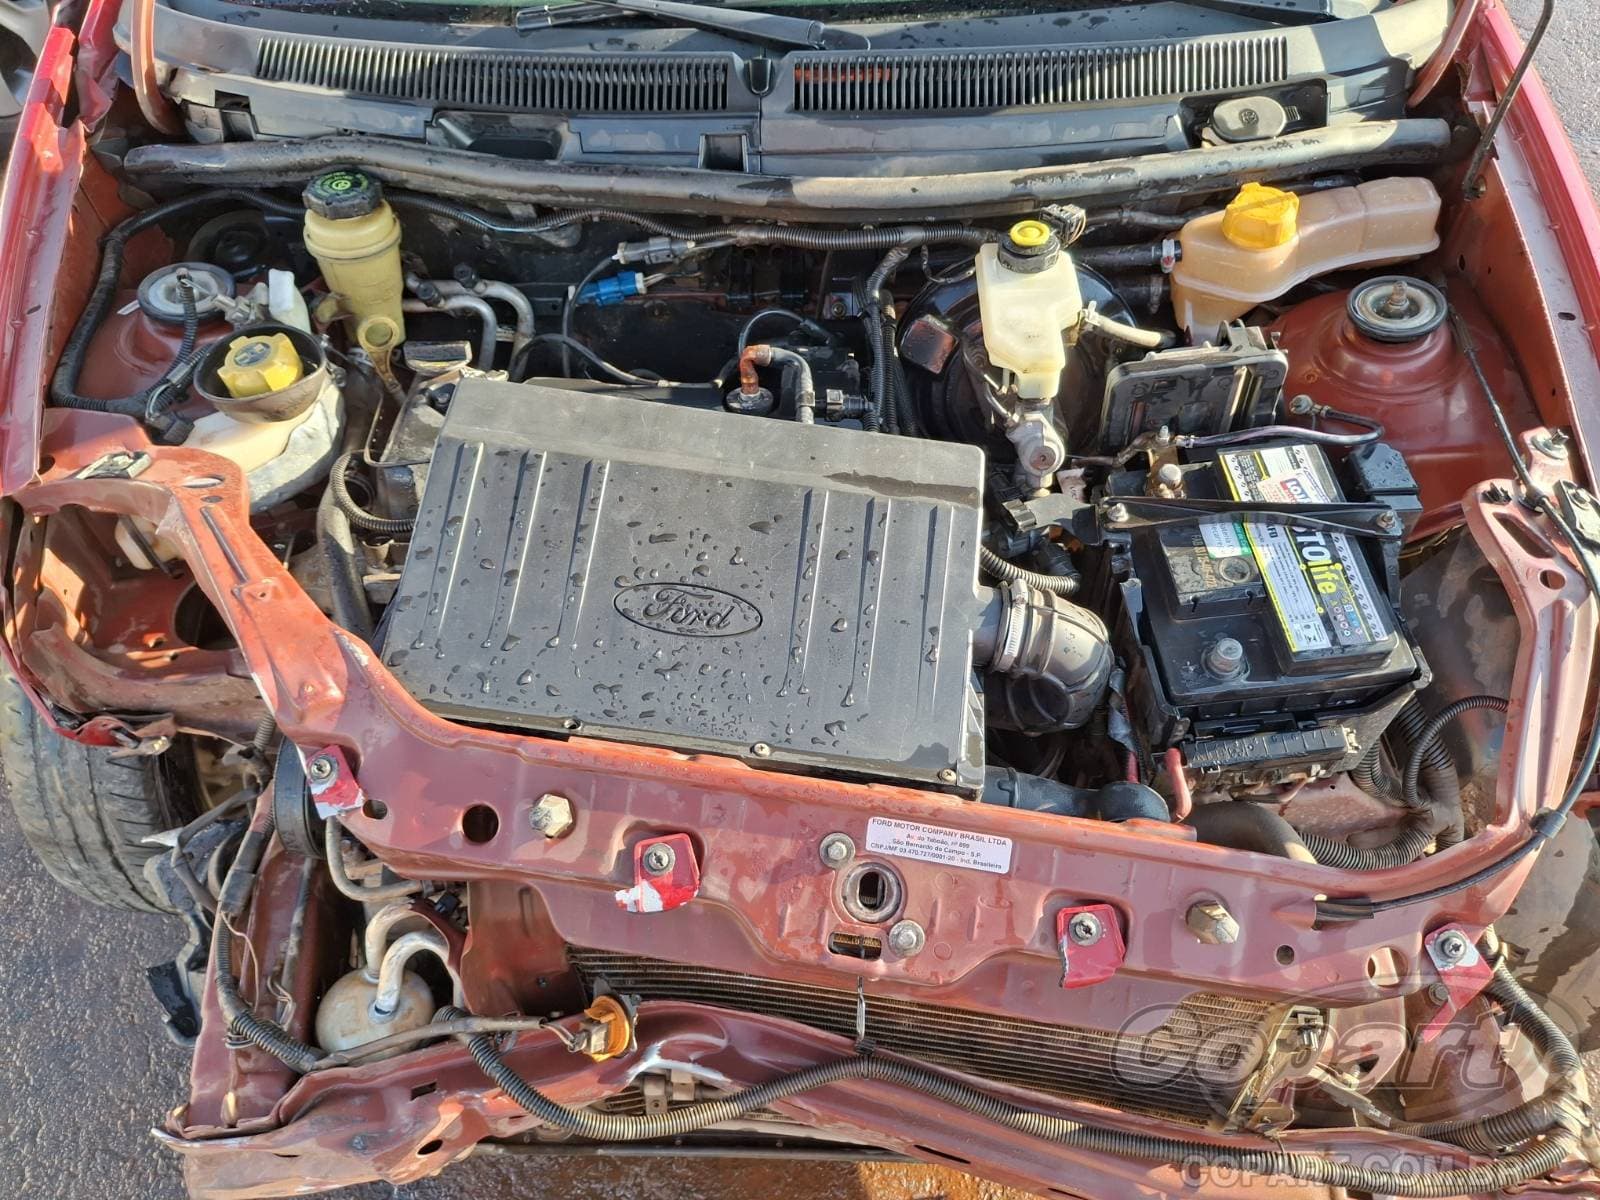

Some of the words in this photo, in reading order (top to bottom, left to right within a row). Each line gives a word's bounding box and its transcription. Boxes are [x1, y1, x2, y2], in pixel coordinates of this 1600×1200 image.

[1292, 526, 1340, 594] TOlife
[643, 588, 735, 630] Ford
[872, 818, 892, 827] FORD
[894, 821, 920, 832] MOTOR
[922, 826, 958, 838] COMPANY
[959, 832, 986, 843] BRASIL
[988, 837, 1007, 846] LTDA
[905, 839, 934, 850] Bernardo
[944, 846, 966, 857] Campo
